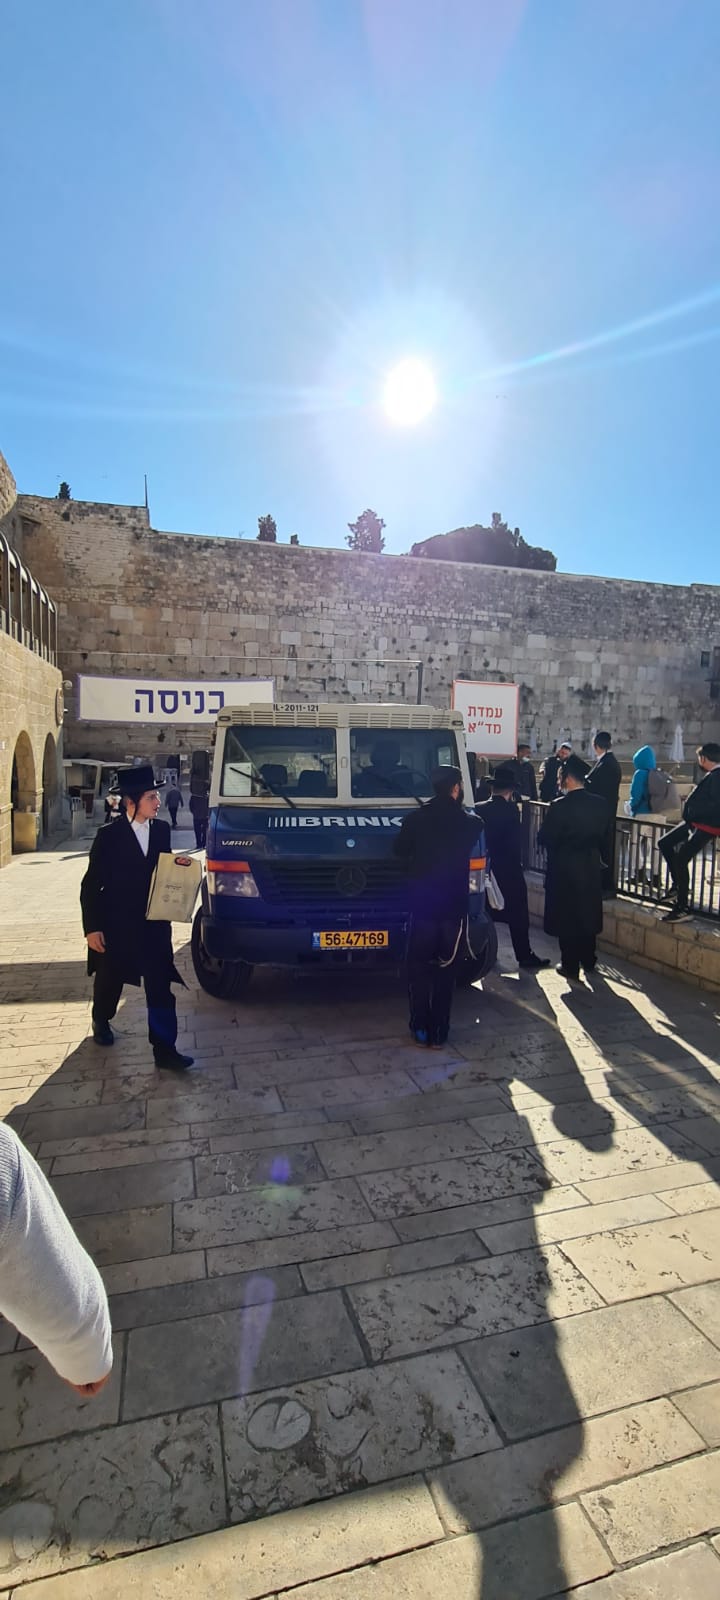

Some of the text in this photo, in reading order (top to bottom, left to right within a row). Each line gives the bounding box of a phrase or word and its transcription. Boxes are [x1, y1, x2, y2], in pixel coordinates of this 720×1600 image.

[134, 689, 225, 714] כניסה
[273, 703, 319, 712] IL-2011-121
[467, 705, 503, 718] עמדת
